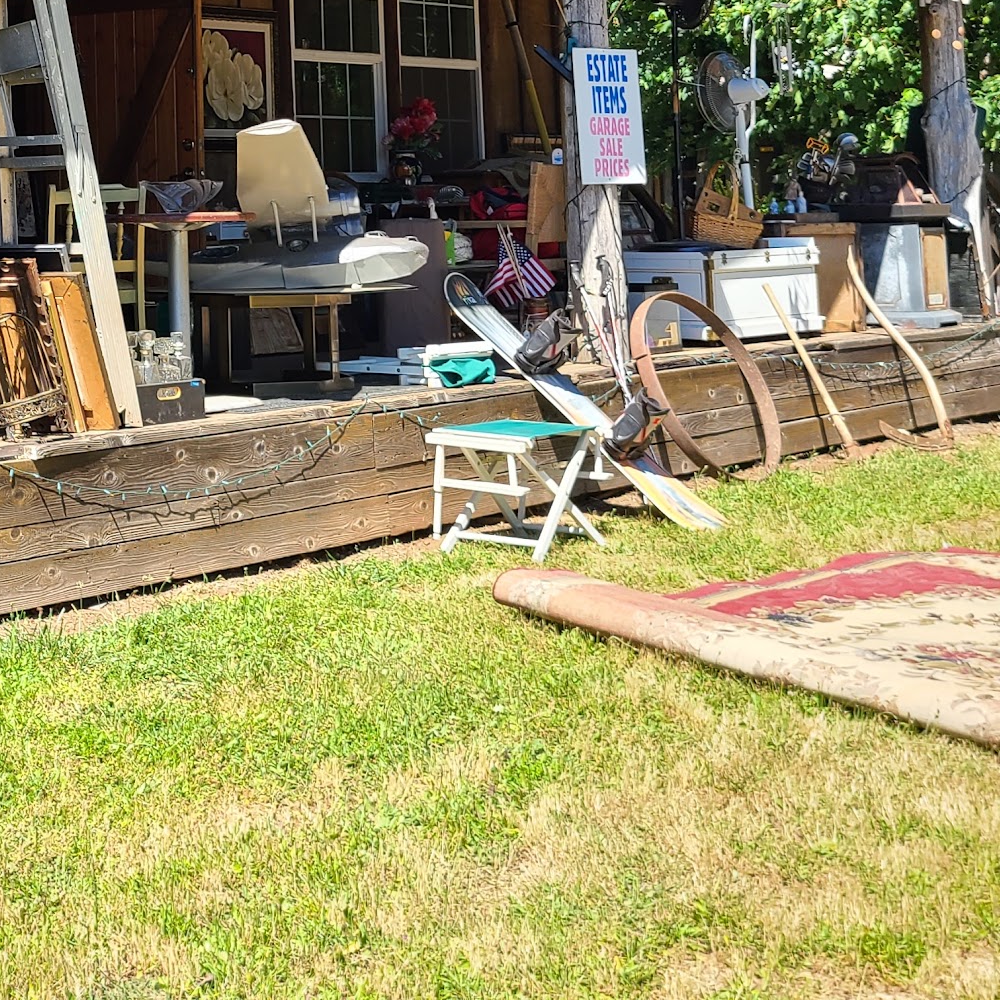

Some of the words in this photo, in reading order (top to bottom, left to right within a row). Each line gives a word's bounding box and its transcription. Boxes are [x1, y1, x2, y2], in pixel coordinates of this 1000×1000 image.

[586, 54, 628, 83] ESTATE
[591, 86, 627, 114] ITEMS
[589, 117, 631, 136] GARAGE
[600, 138, 624, 157] SALE
[594, 158, 630, 177] PRICES
